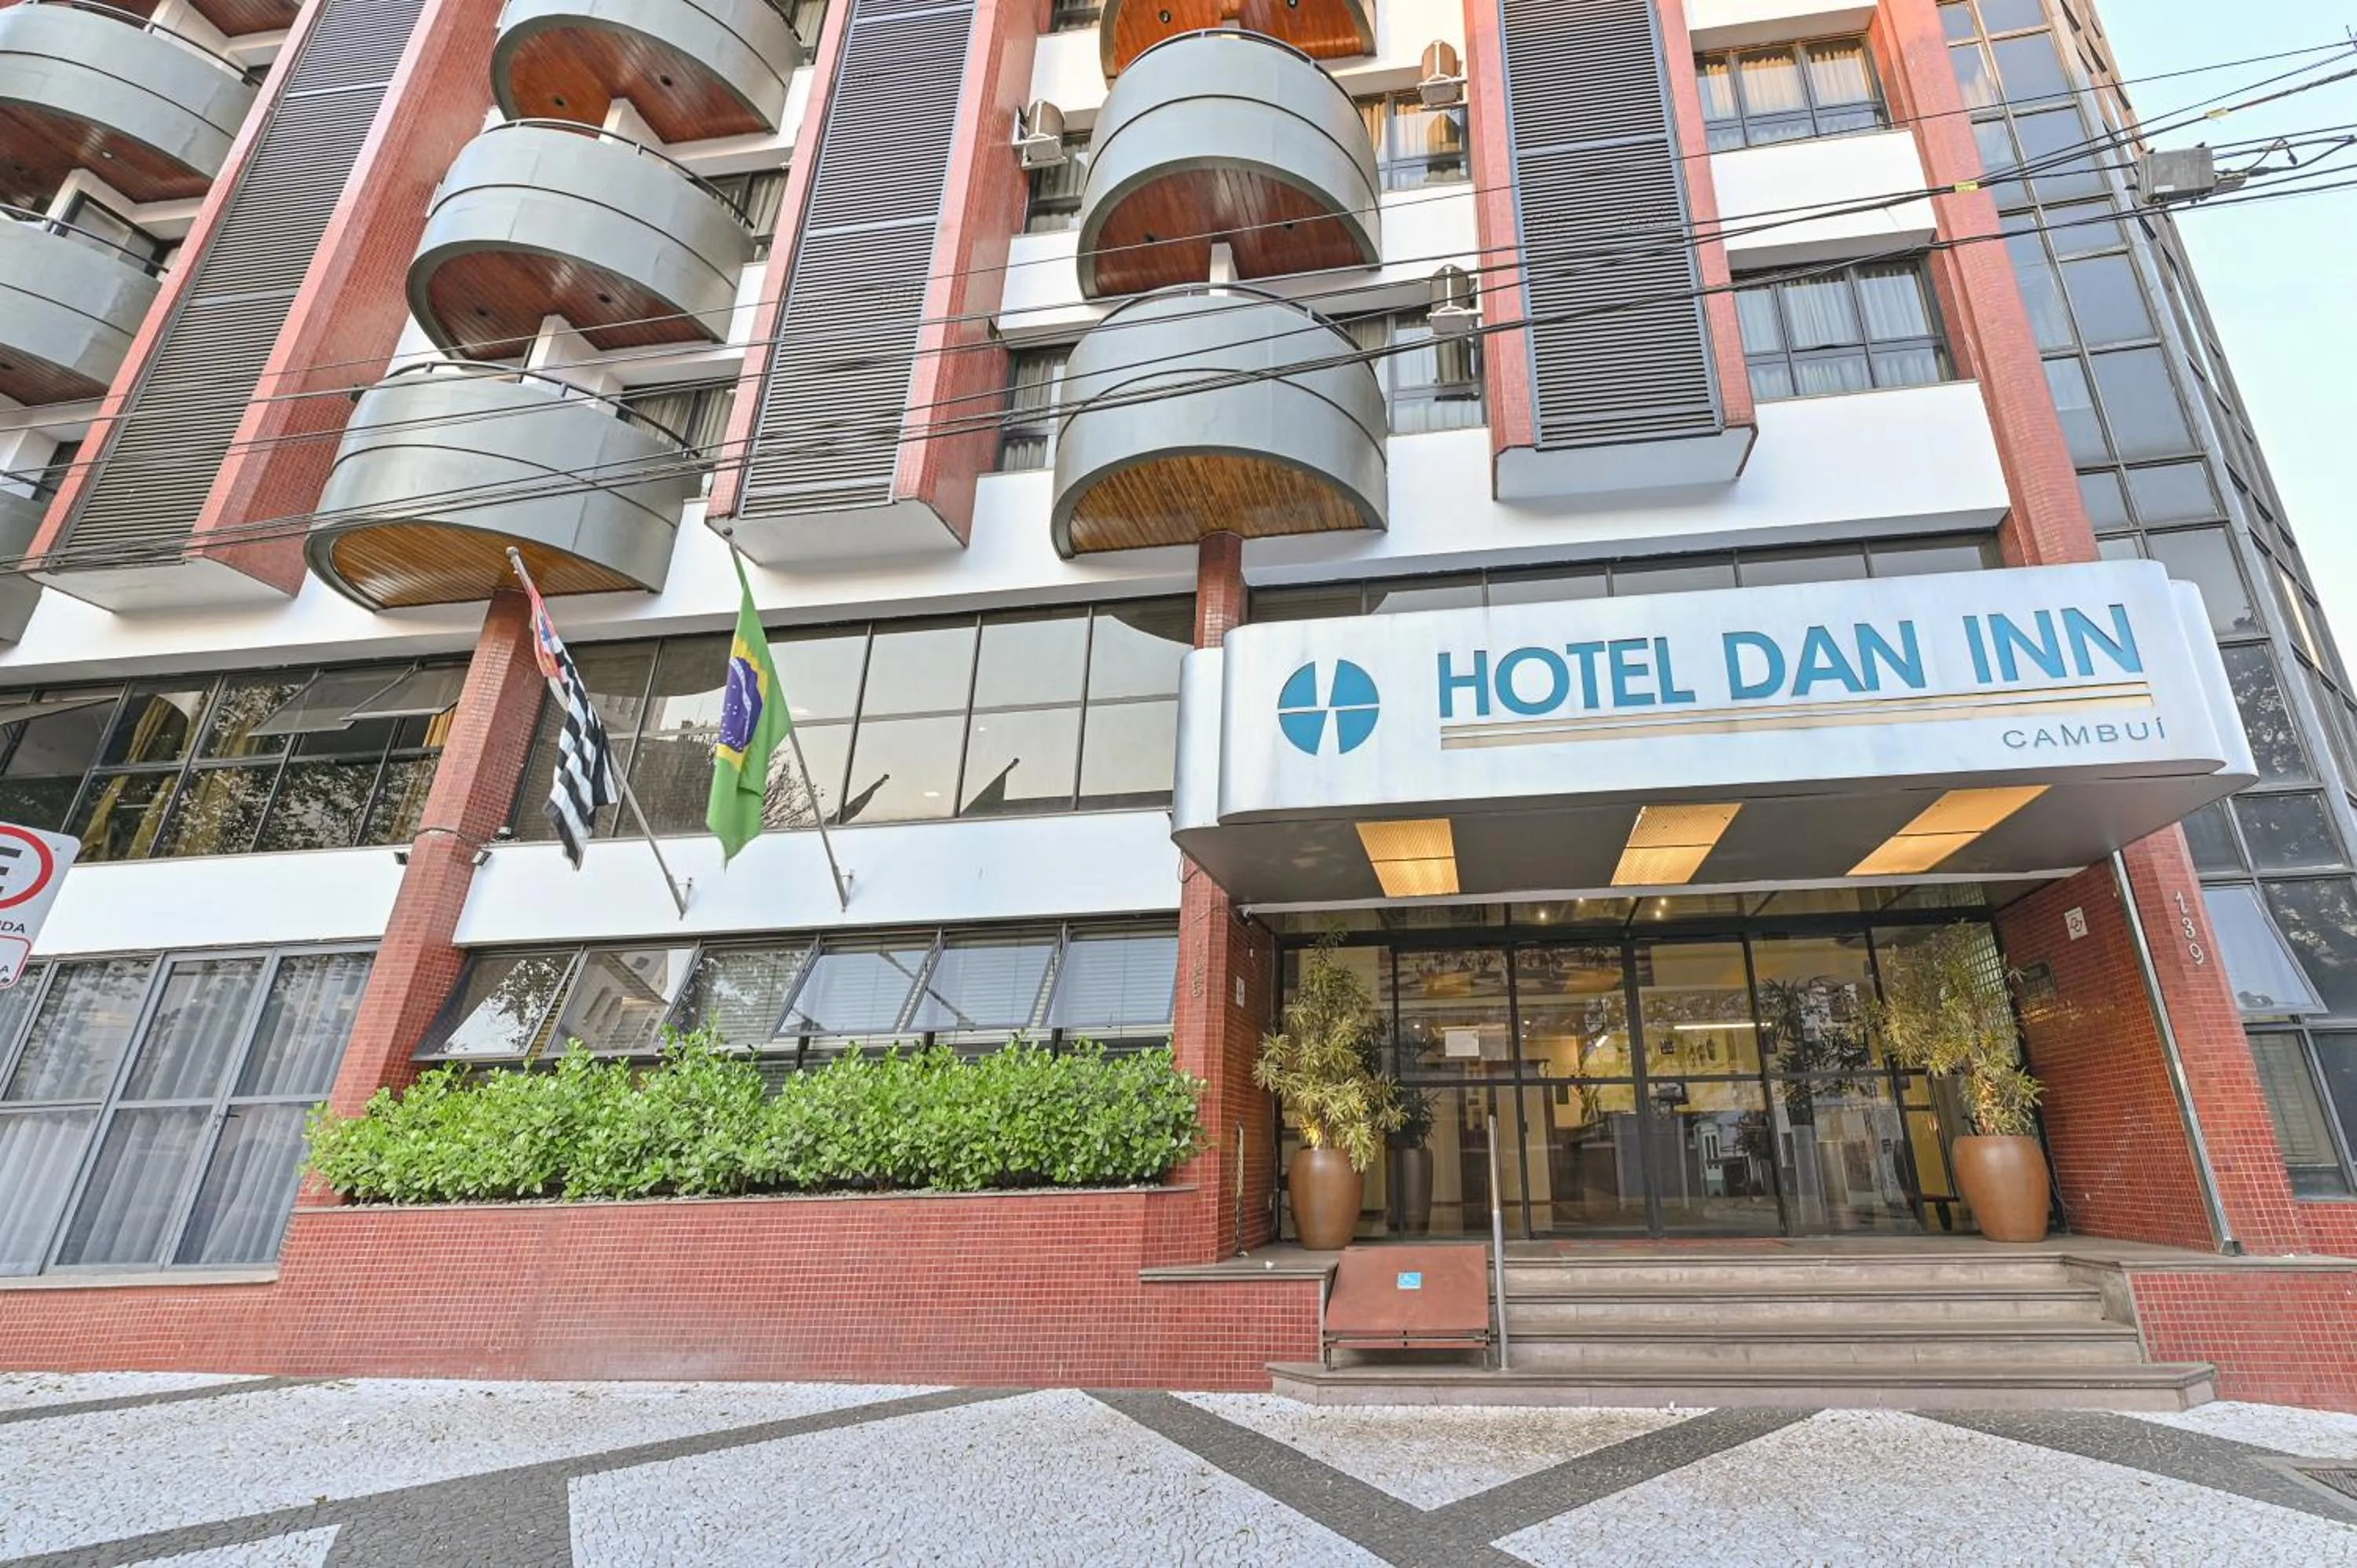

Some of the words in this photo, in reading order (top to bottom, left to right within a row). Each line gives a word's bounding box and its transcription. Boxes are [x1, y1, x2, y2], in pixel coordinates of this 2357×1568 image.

[1437, 636, 1695, 718] HOTEL
[1721, 620, 1926, 700] DAN
[1963, 603, 2143, 683] INN
[2003, 716, 2165, 749] CAMBUÍ
[0, 920, 26, 934] DA
[2175, 891, 2205, 966] 139
